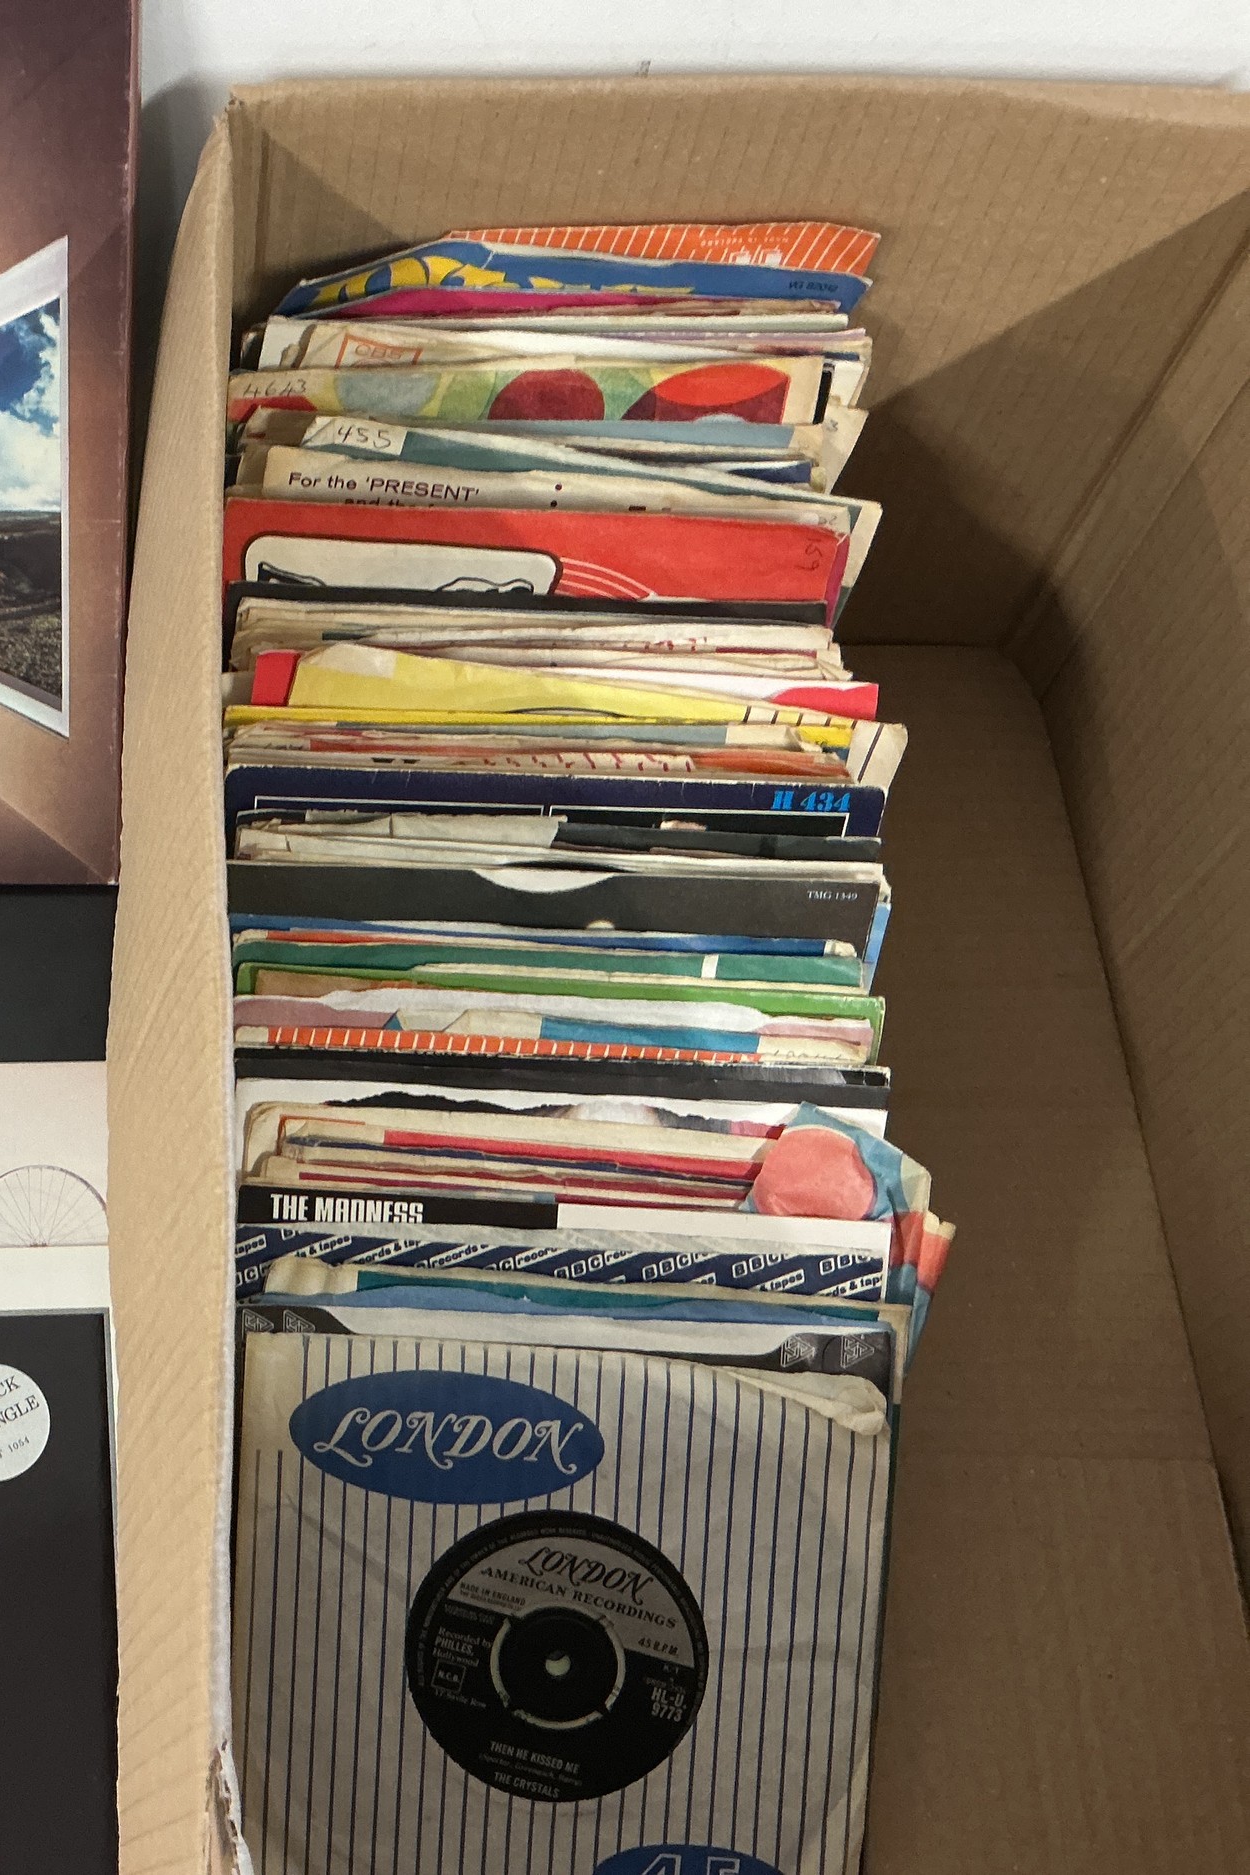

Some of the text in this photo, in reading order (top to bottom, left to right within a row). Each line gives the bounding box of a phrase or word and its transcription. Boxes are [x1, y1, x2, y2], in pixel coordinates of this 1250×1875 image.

[242, 378, 307, 399] 4643
[336, 424, 392, 449] 455
[288, 472, 480, 502] For the 'PRESENT'
[771, 790, 851, 812] H 434
[807, 890, 833, 900] TMG
[270, 1193, 424, 1224] THE MADNESS
[8, 1436, 30, 1452] 1054
[313, 1407, 584, 1475] LONDON
[518, 1546, 654, 1606] LONDON
[481, 1566, 678, 1629] AMERICAN RECORDINGS
[482, 1587, 491, 1597] IN
[638, 1637, 650, 1648] 45
[651, 1702, 683, 1722] 9773
[490, 1741, 515, 1757] THEN
[531, 1752, 563, 1769] KISSED
[494, 1771, 560, 1798] THE CRYSTALS
